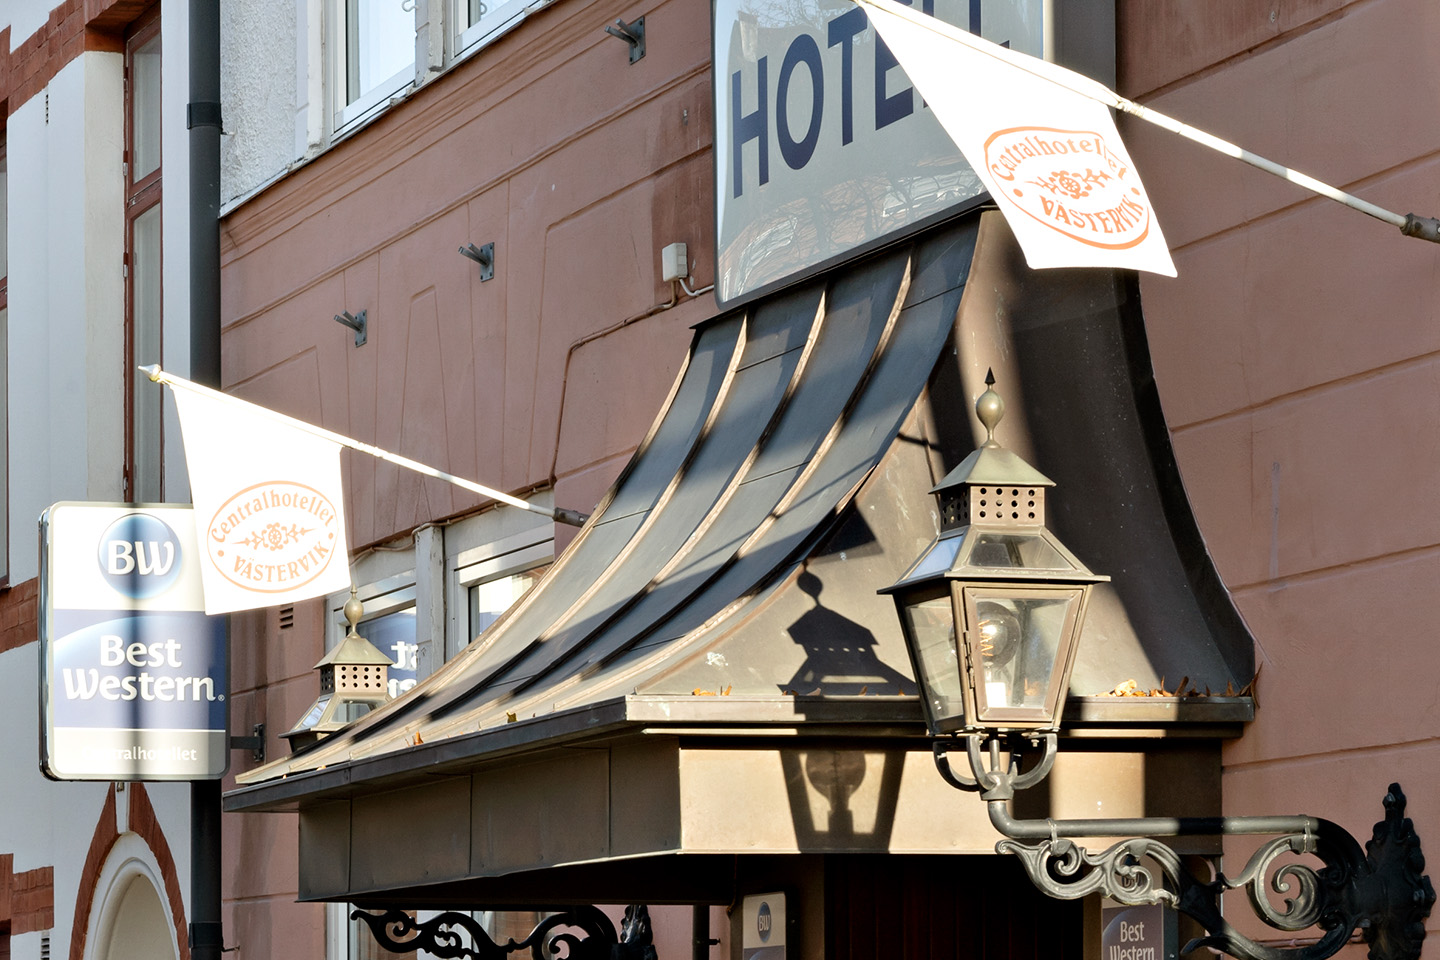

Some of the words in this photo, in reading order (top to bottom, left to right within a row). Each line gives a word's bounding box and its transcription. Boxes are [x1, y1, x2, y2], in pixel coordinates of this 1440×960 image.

[732, 0, 1010, 199] HOTE
[1039, 194, 1144, 234] VÄSTERVIK
[211, 489, 334, 543] Centralhotellet
[107, 540, 175, 576] BW
[233, 541, 329, 583] VÄSTERVIK
[100, 635, 182, 668] Best
[1120, 921, 1145, 942] Best
